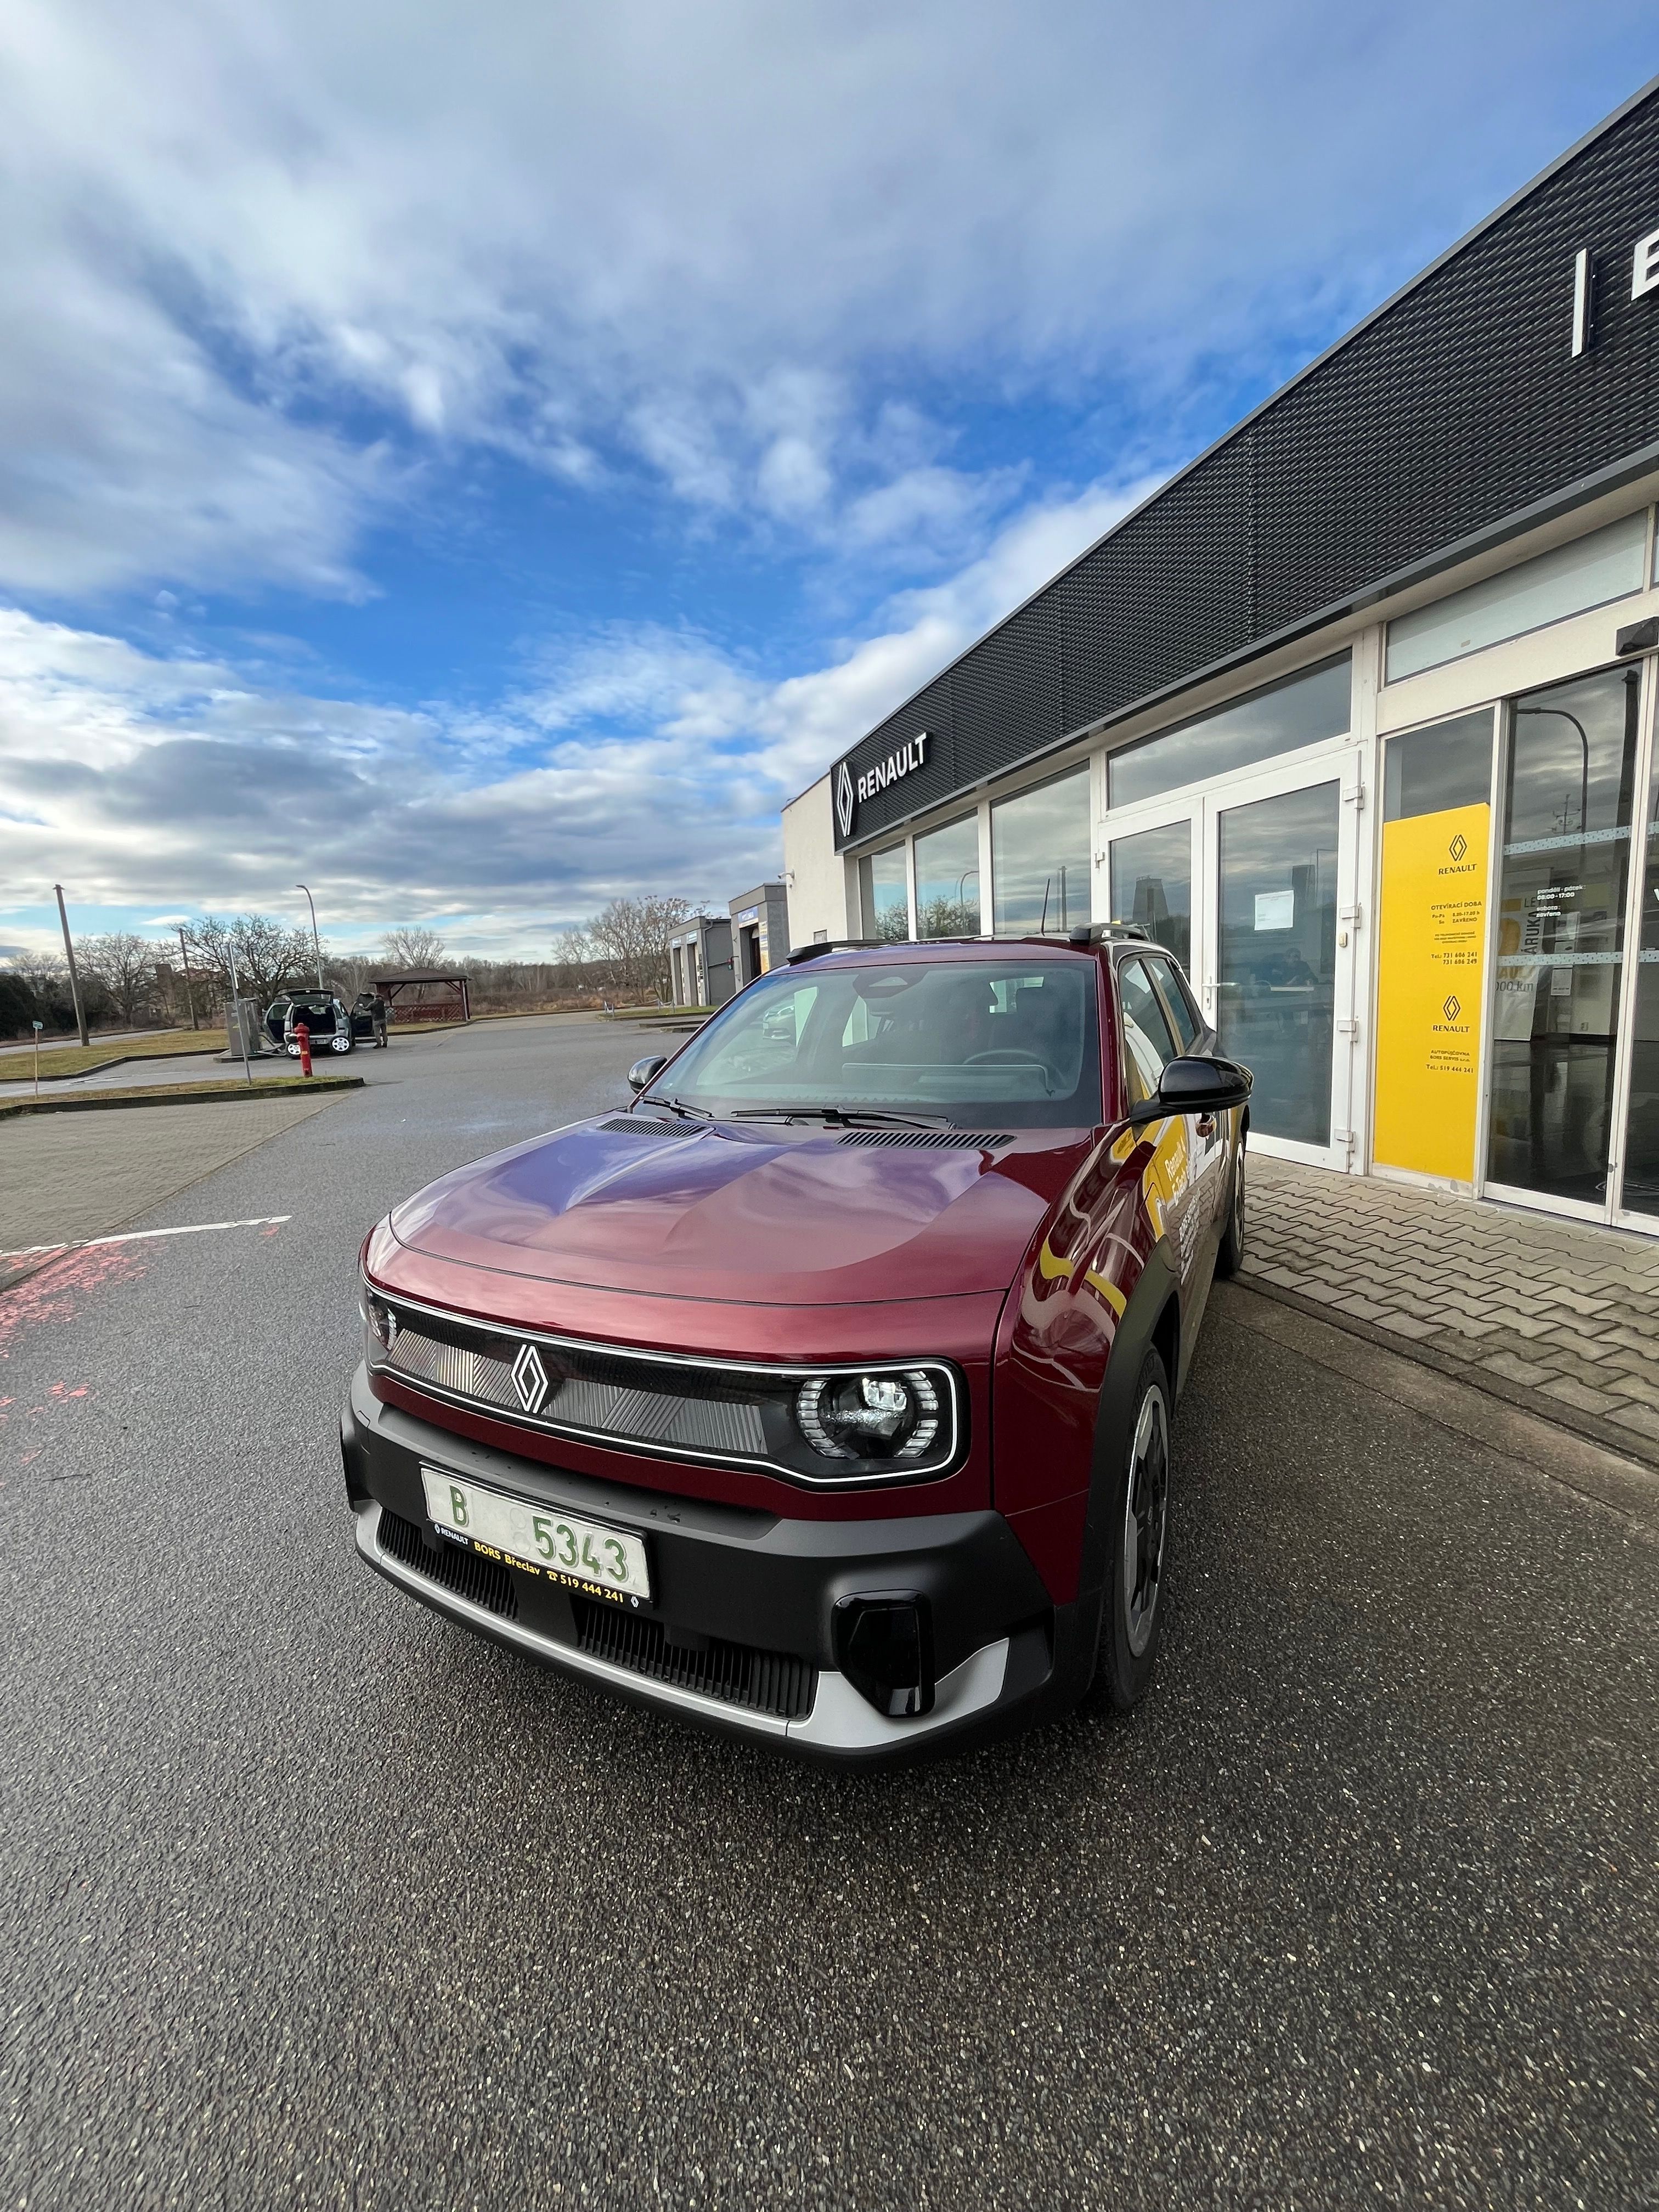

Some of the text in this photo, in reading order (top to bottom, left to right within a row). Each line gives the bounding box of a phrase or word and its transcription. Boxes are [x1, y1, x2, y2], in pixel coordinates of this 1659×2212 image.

[857, 732, 927, 803] RENAULT
[1438, 864, 1478, 875] RENAULT
[1431, 901, 1463, 910] OTEVÍRACÍ
[1516, 980, 1533, 992] km
[1164, 1141, 1184, 1182] Renault
[449, 1485, 629, 1582] B 5343
[441, 1527, 624, 1603] RENAULT BORS Břeclav 519 444 241
